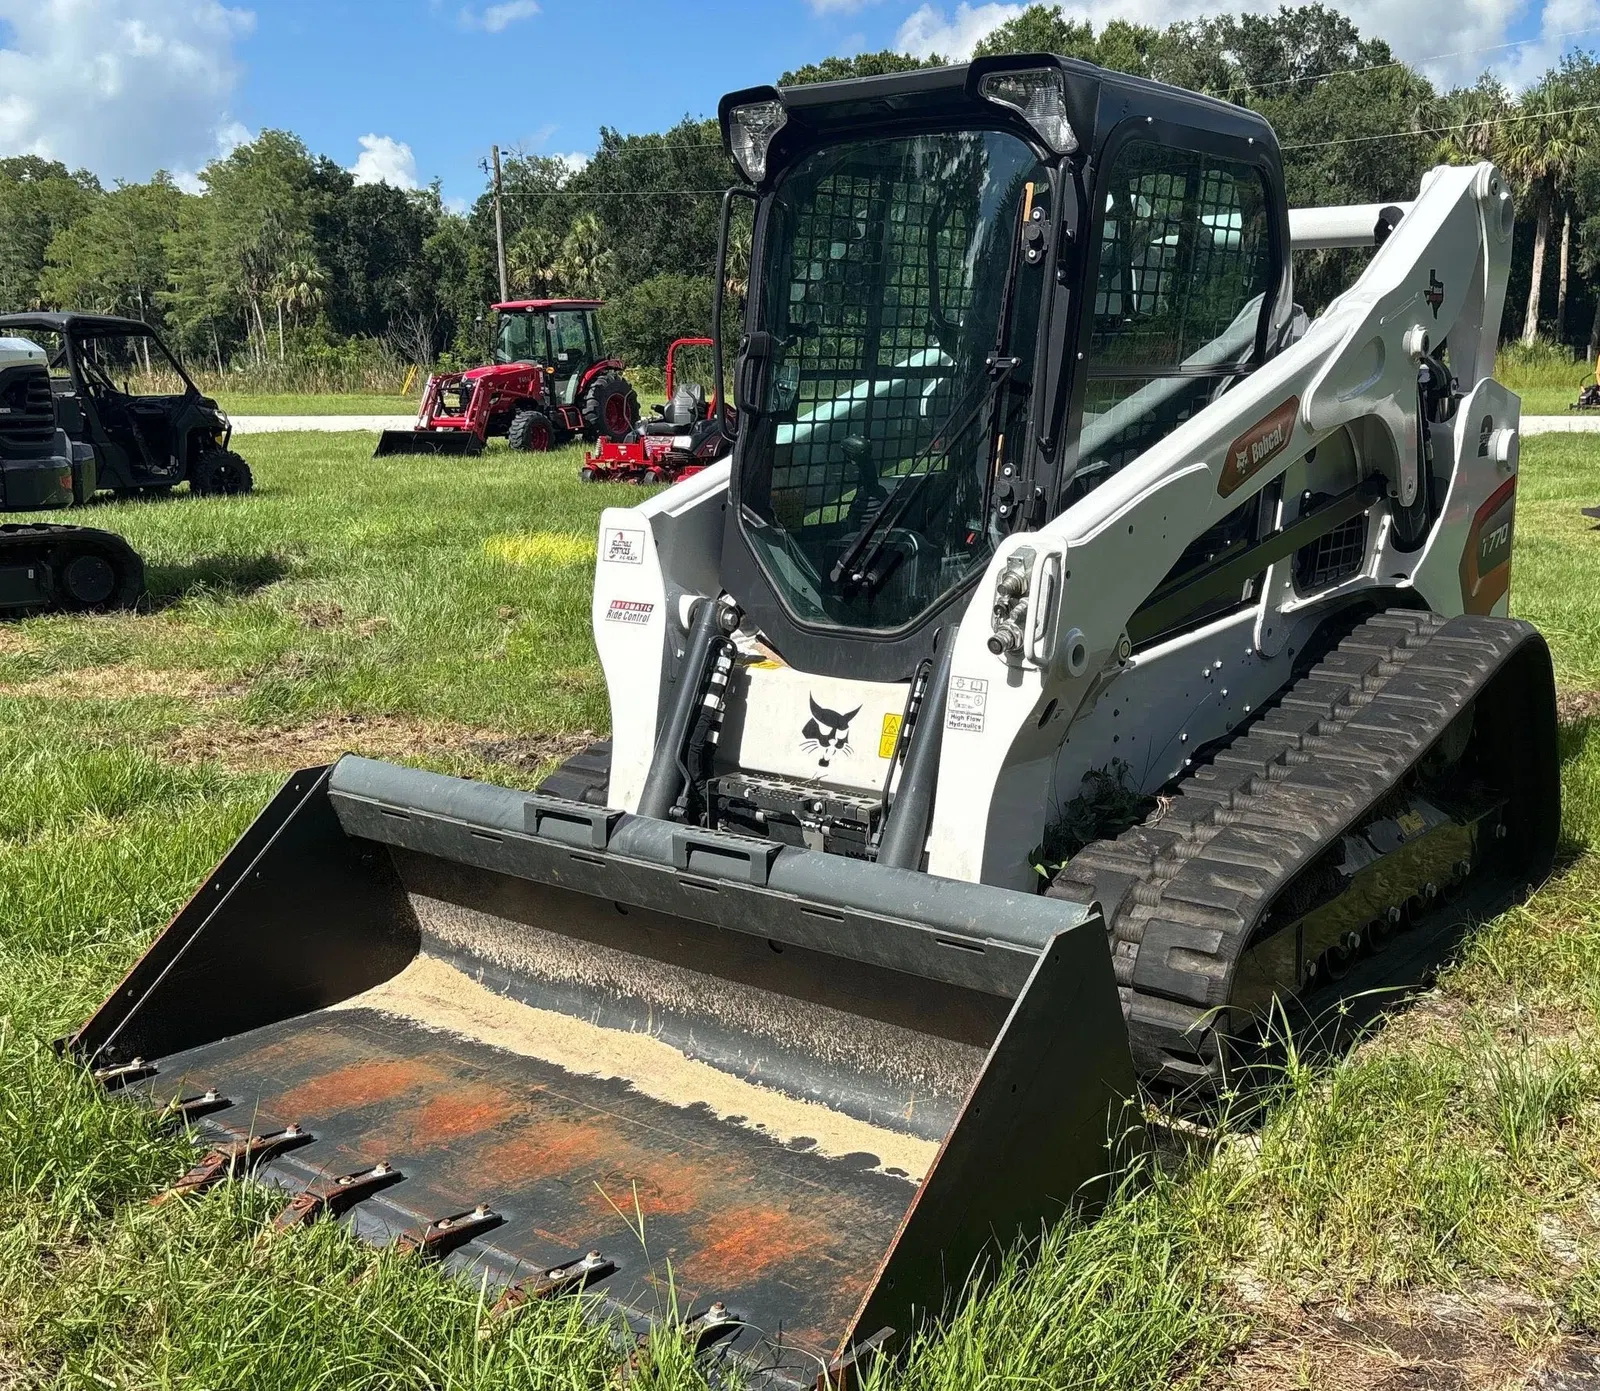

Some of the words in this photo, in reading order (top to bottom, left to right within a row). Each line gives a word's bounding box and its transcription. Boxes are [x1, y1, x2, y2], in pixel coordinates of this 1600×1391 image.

[1251, 423, 1283, 464] Bobcat
[1482, 522, 1509, 557] T770
[610, 600, 653, 612] AUTOMATIC
[606, 609, 622, 620] Ride
[623, 611, 650, 623] Control
[949, 721, 982, 730] Hydraulics
